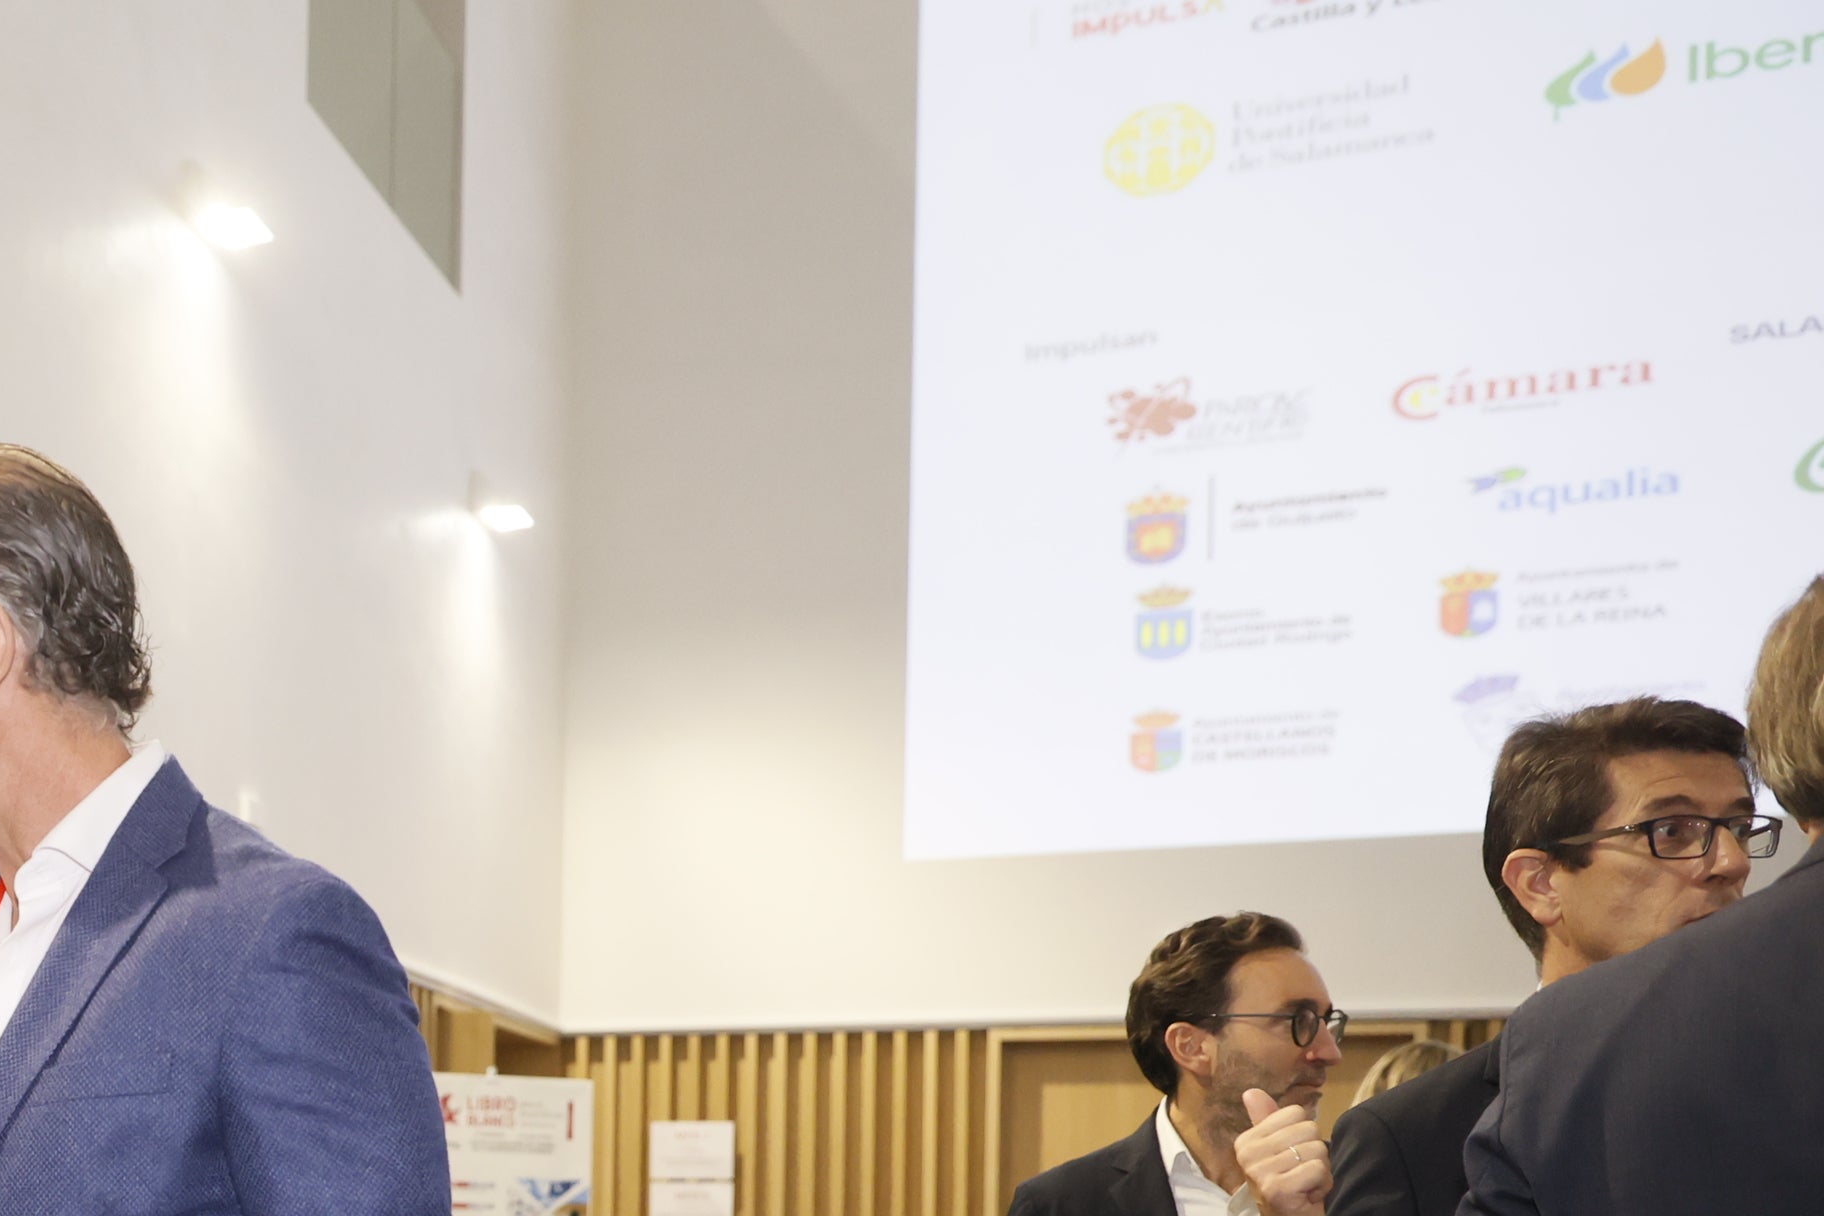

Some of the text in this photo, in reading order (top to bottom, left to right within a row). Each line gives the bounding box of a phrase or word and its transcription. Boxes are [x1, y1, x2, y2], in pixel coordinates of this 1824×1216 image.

[1250, 0, 1377, 33] Castilla y
[1689, 31, 1824, 82] Iber
[1232, 73, 1410, 121] Universidad
[1730, 316, 1824, 345] SALA
[1391, 361, 1656, 422] Cámara
[1498, 466, 1680, 514] aqualia
[465, 1096, 516, 1111] LIBRO
